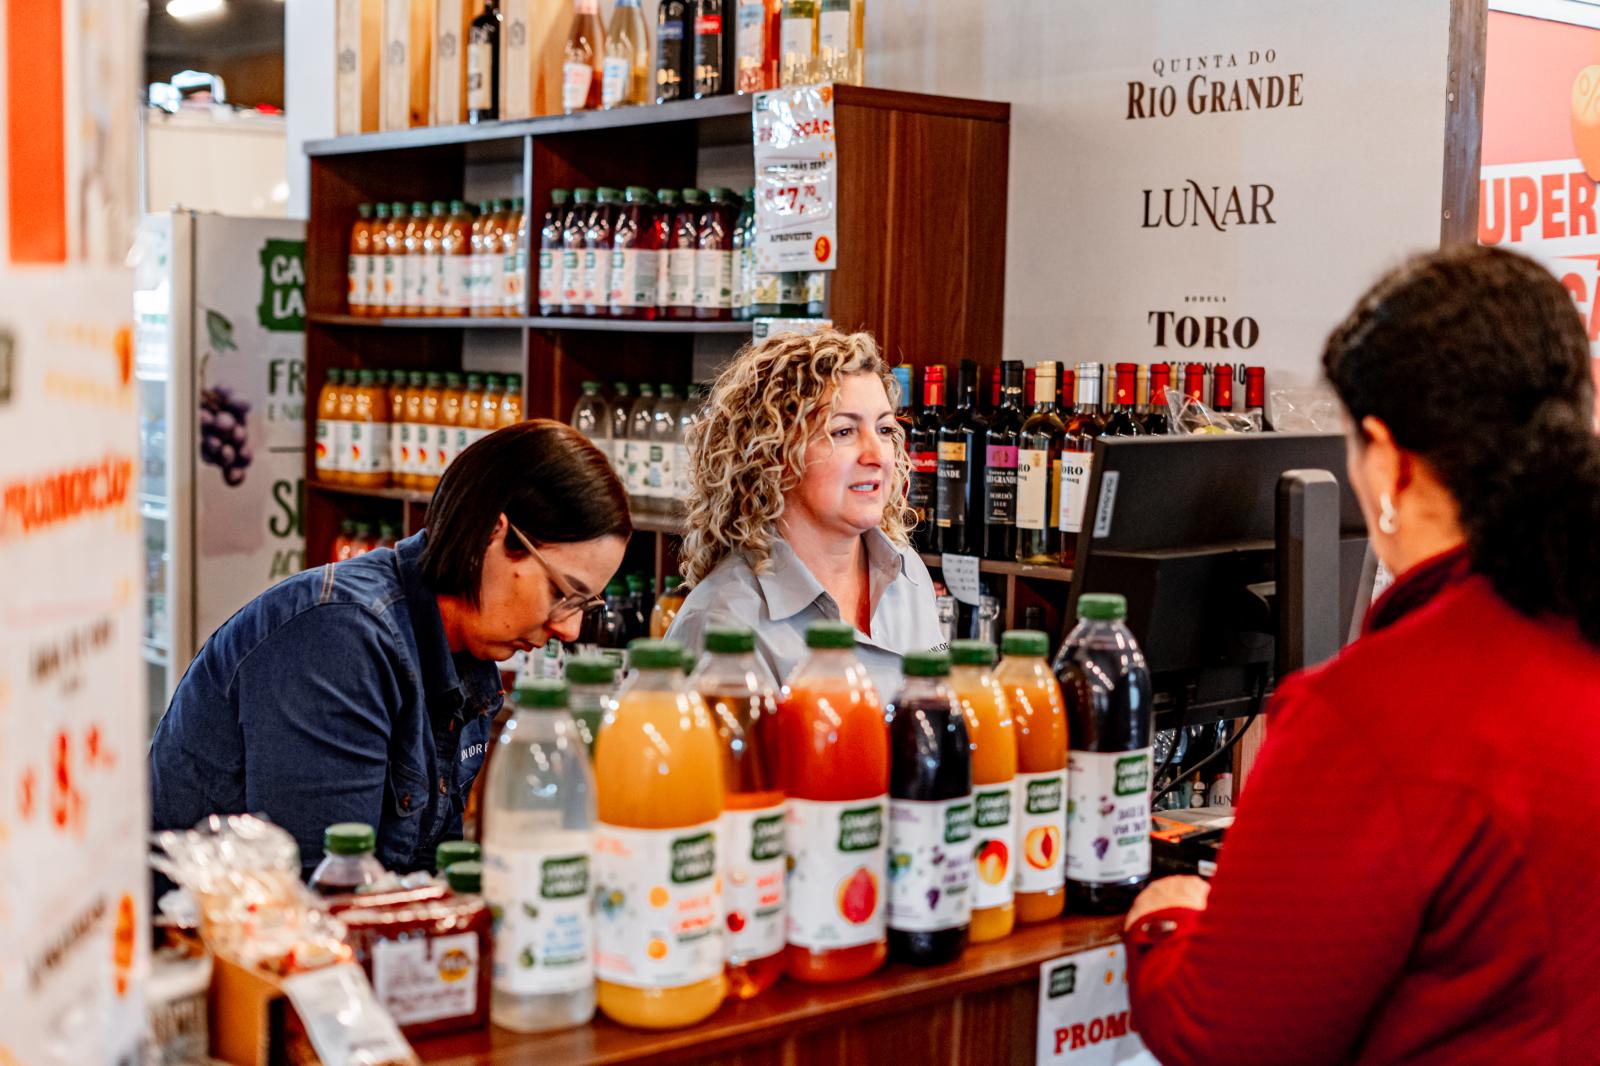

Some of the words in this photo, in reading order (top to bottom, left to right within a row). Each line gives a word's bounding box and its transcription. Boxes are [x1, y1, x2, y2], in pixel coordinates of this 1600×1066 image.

[1152, 54, 1238, 77] QUINTA
[1249, 48, 1277, 65] DO
[1126, 80, 1177, 120] RIO
[1186, 73, 1304, 115] GRANDE
[1141, 179, 1277, 232] LUNAR
[1148, 310, 1260, 350] TORO
